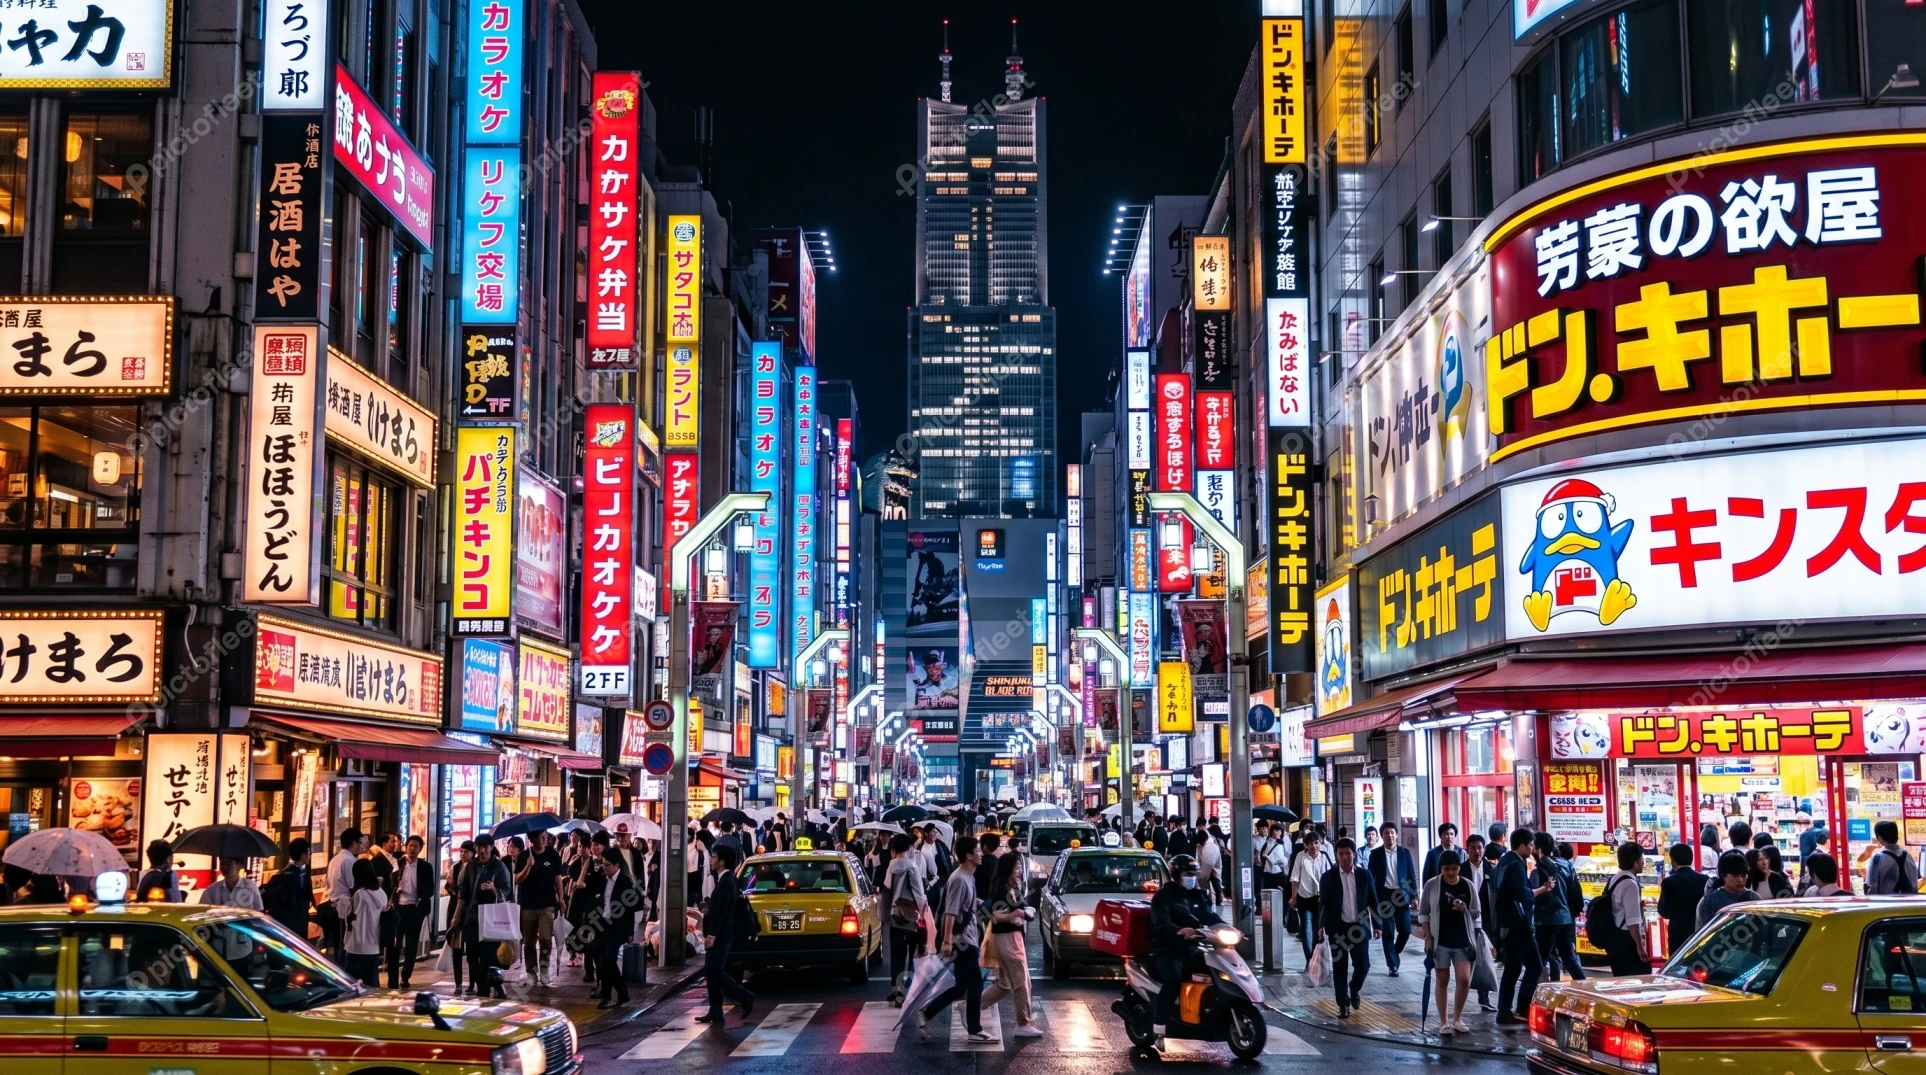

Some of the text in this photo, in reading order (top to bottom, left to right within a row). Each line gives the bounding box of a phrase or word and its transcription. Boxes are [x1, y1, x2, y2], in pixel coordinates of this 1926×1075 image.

[479, 2, 510, 132] カラオケ
[266, 162, 305, 307] 居酒はや
[474, 159, 505, 312] リケフ交場
[11, 330, 107, 378] まら
[673, 368, 692, 426] ラント
[258, 434, 297, 592] ほほうどん
[462, 452, 493, 610] パチキンコ
